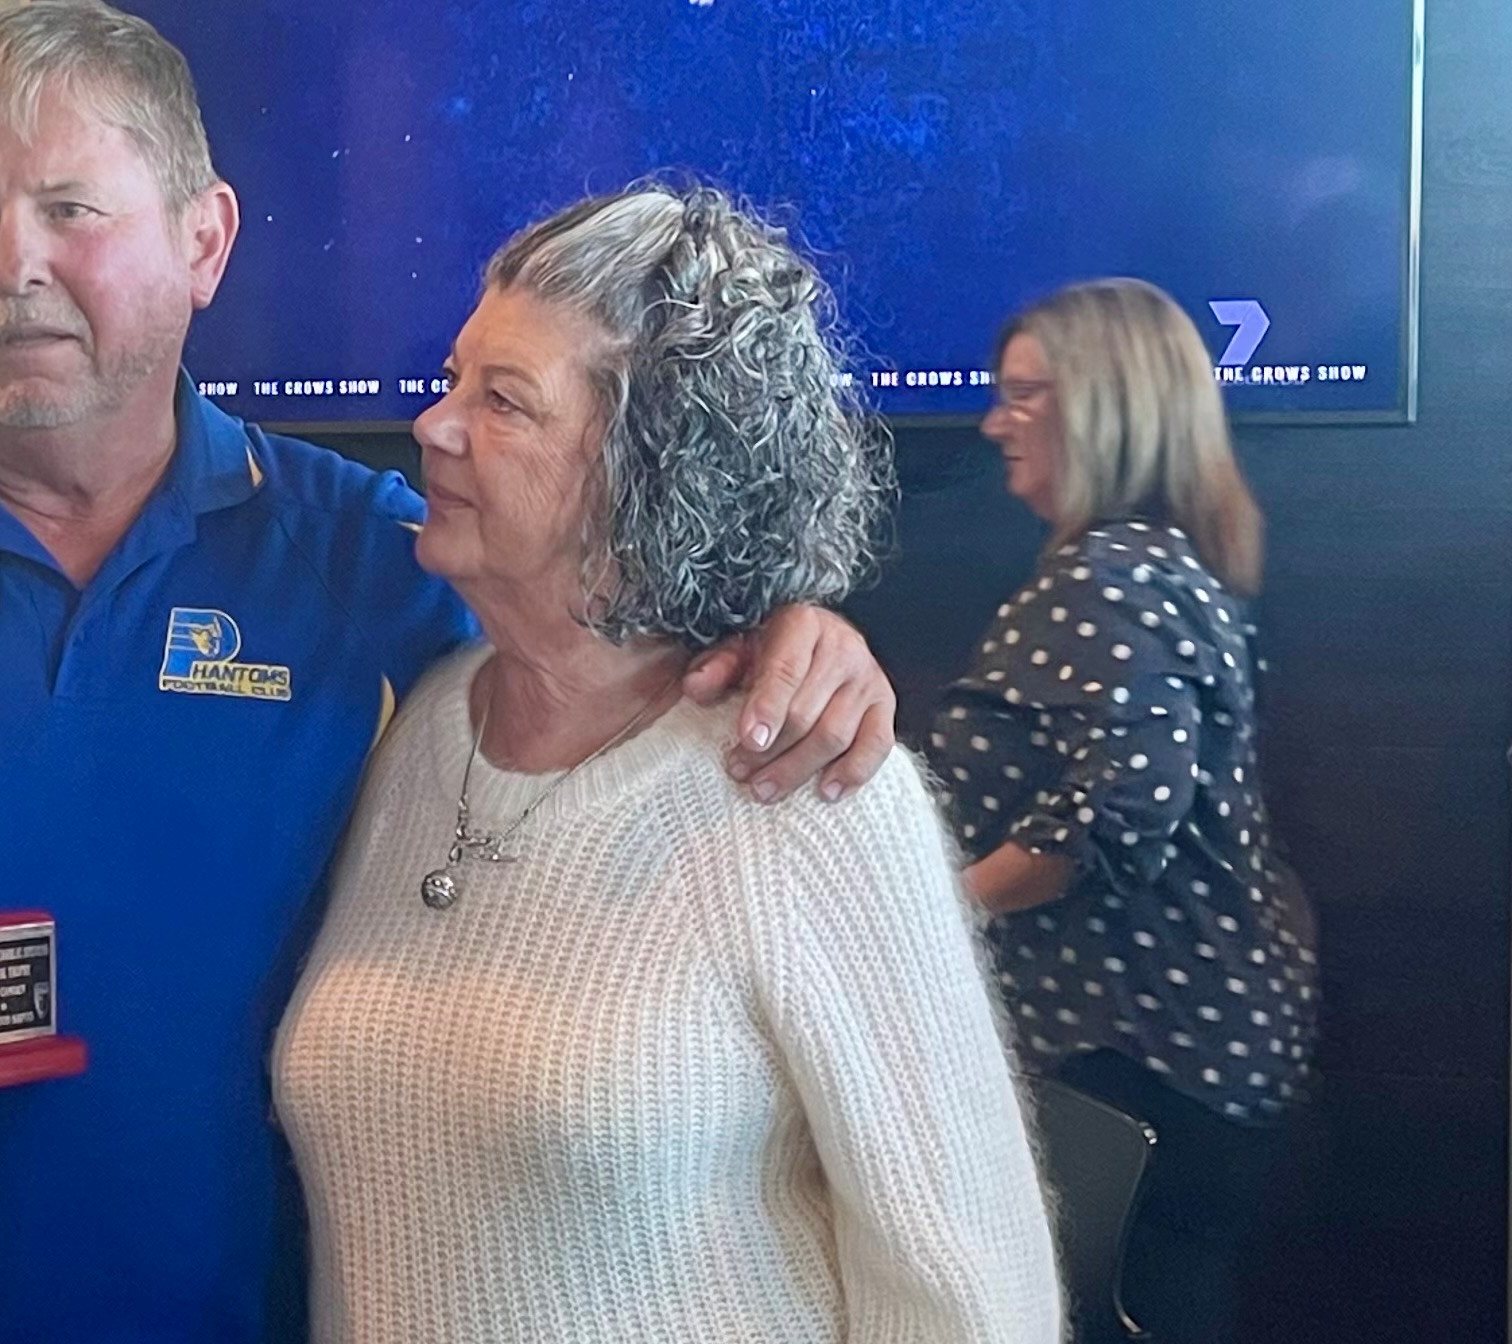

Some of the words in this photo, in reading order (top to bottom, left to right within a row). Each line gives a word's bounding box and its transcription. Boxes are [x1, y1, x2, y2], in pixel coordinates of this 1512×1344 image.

[1208, 300, 1271, 365] 7
[871, 371, 899, 387] THE
[906, 370, 963, 387] CROWS
[969, 370, 996, 386] SH
[1214, 366, 1244, 382] THE
[1250, 365, 1310, 382] CROWS
[1317, 365, 1366, 381] SHOW
[198, 382, 238, 396] SHOW
[253, 381, 279, 396] THE
[284, 380, 334, 395] CROWS
[339, 380, 380, 394] SHOW
[399, 379, 425, 394] THE
[162, 678, 243, 695] FOOTBALL
